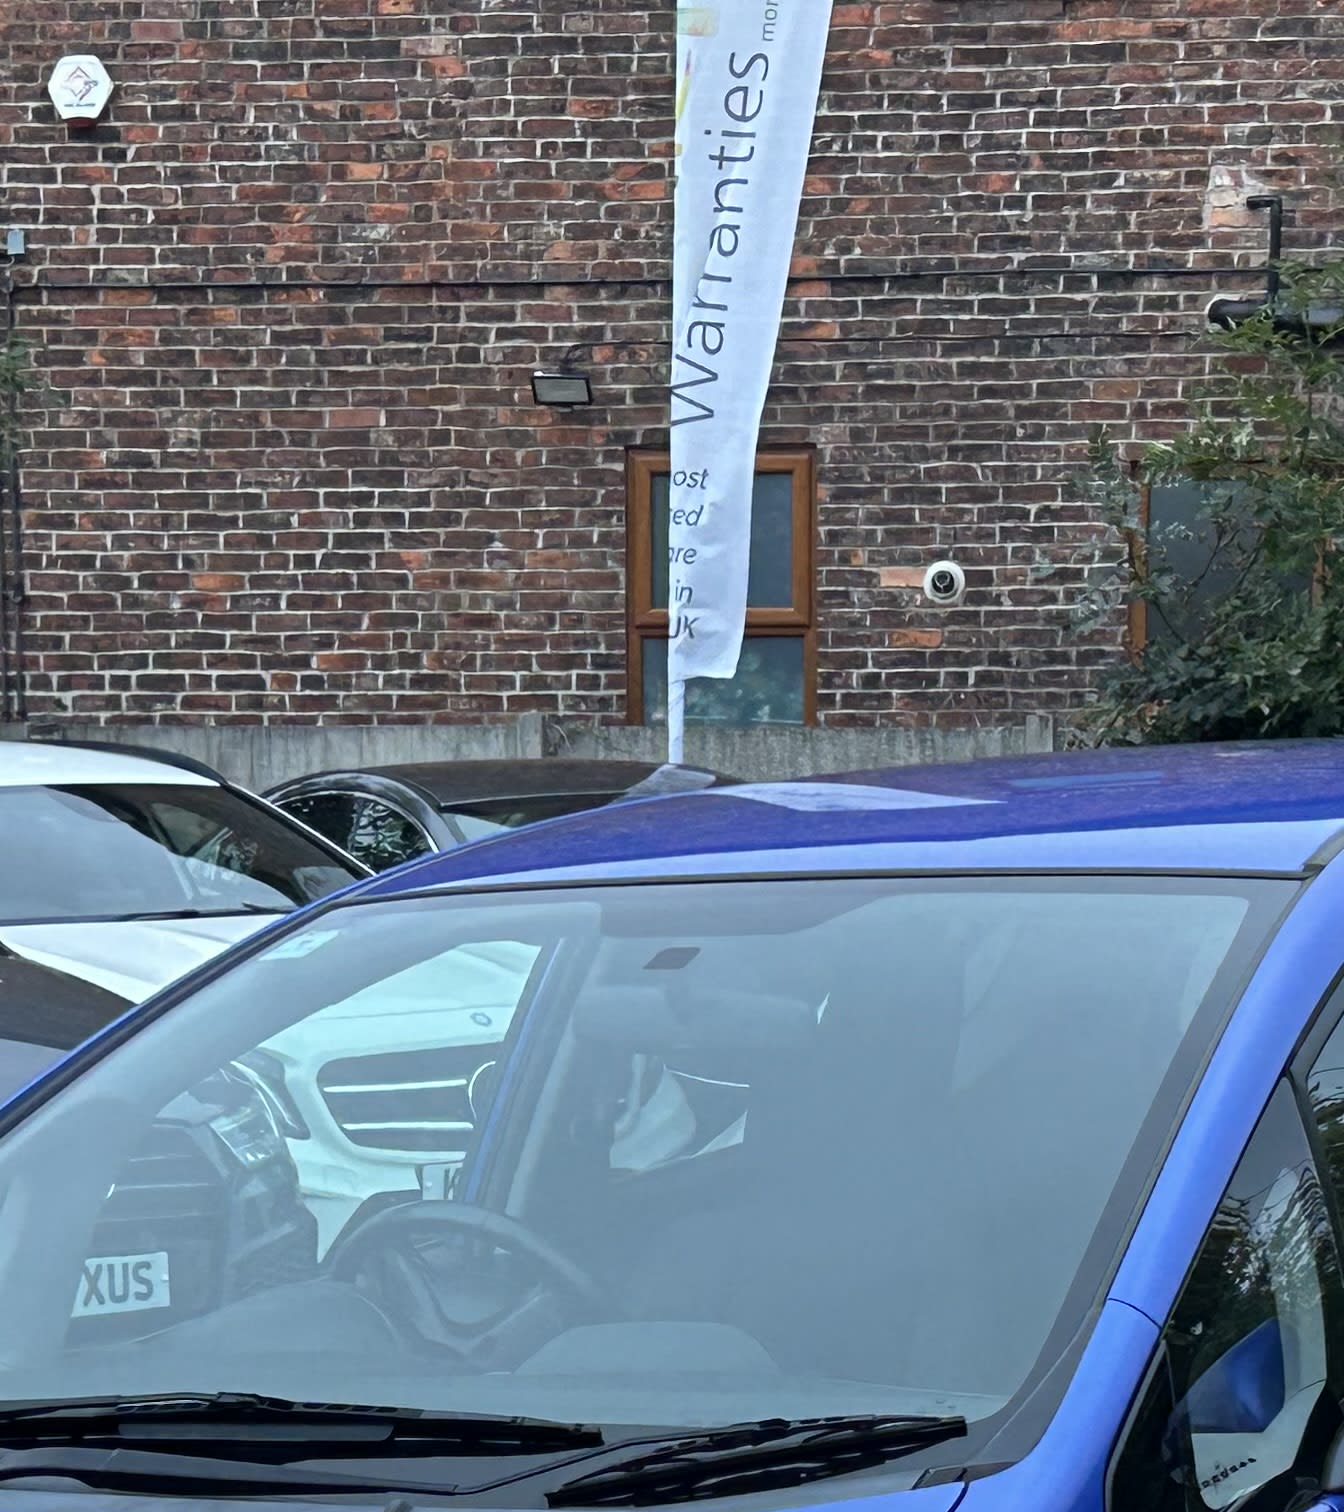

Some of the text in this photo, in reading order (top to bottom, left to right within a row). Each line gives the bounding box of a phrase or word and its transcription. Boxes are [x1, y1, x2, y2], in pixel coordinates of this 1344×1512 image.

[670, 51, 769, 427] Warranties
[669, 504, 704, 526] ed
[675, 579, 693, 604] in
[82, 1260, 154, 1307] XUS
